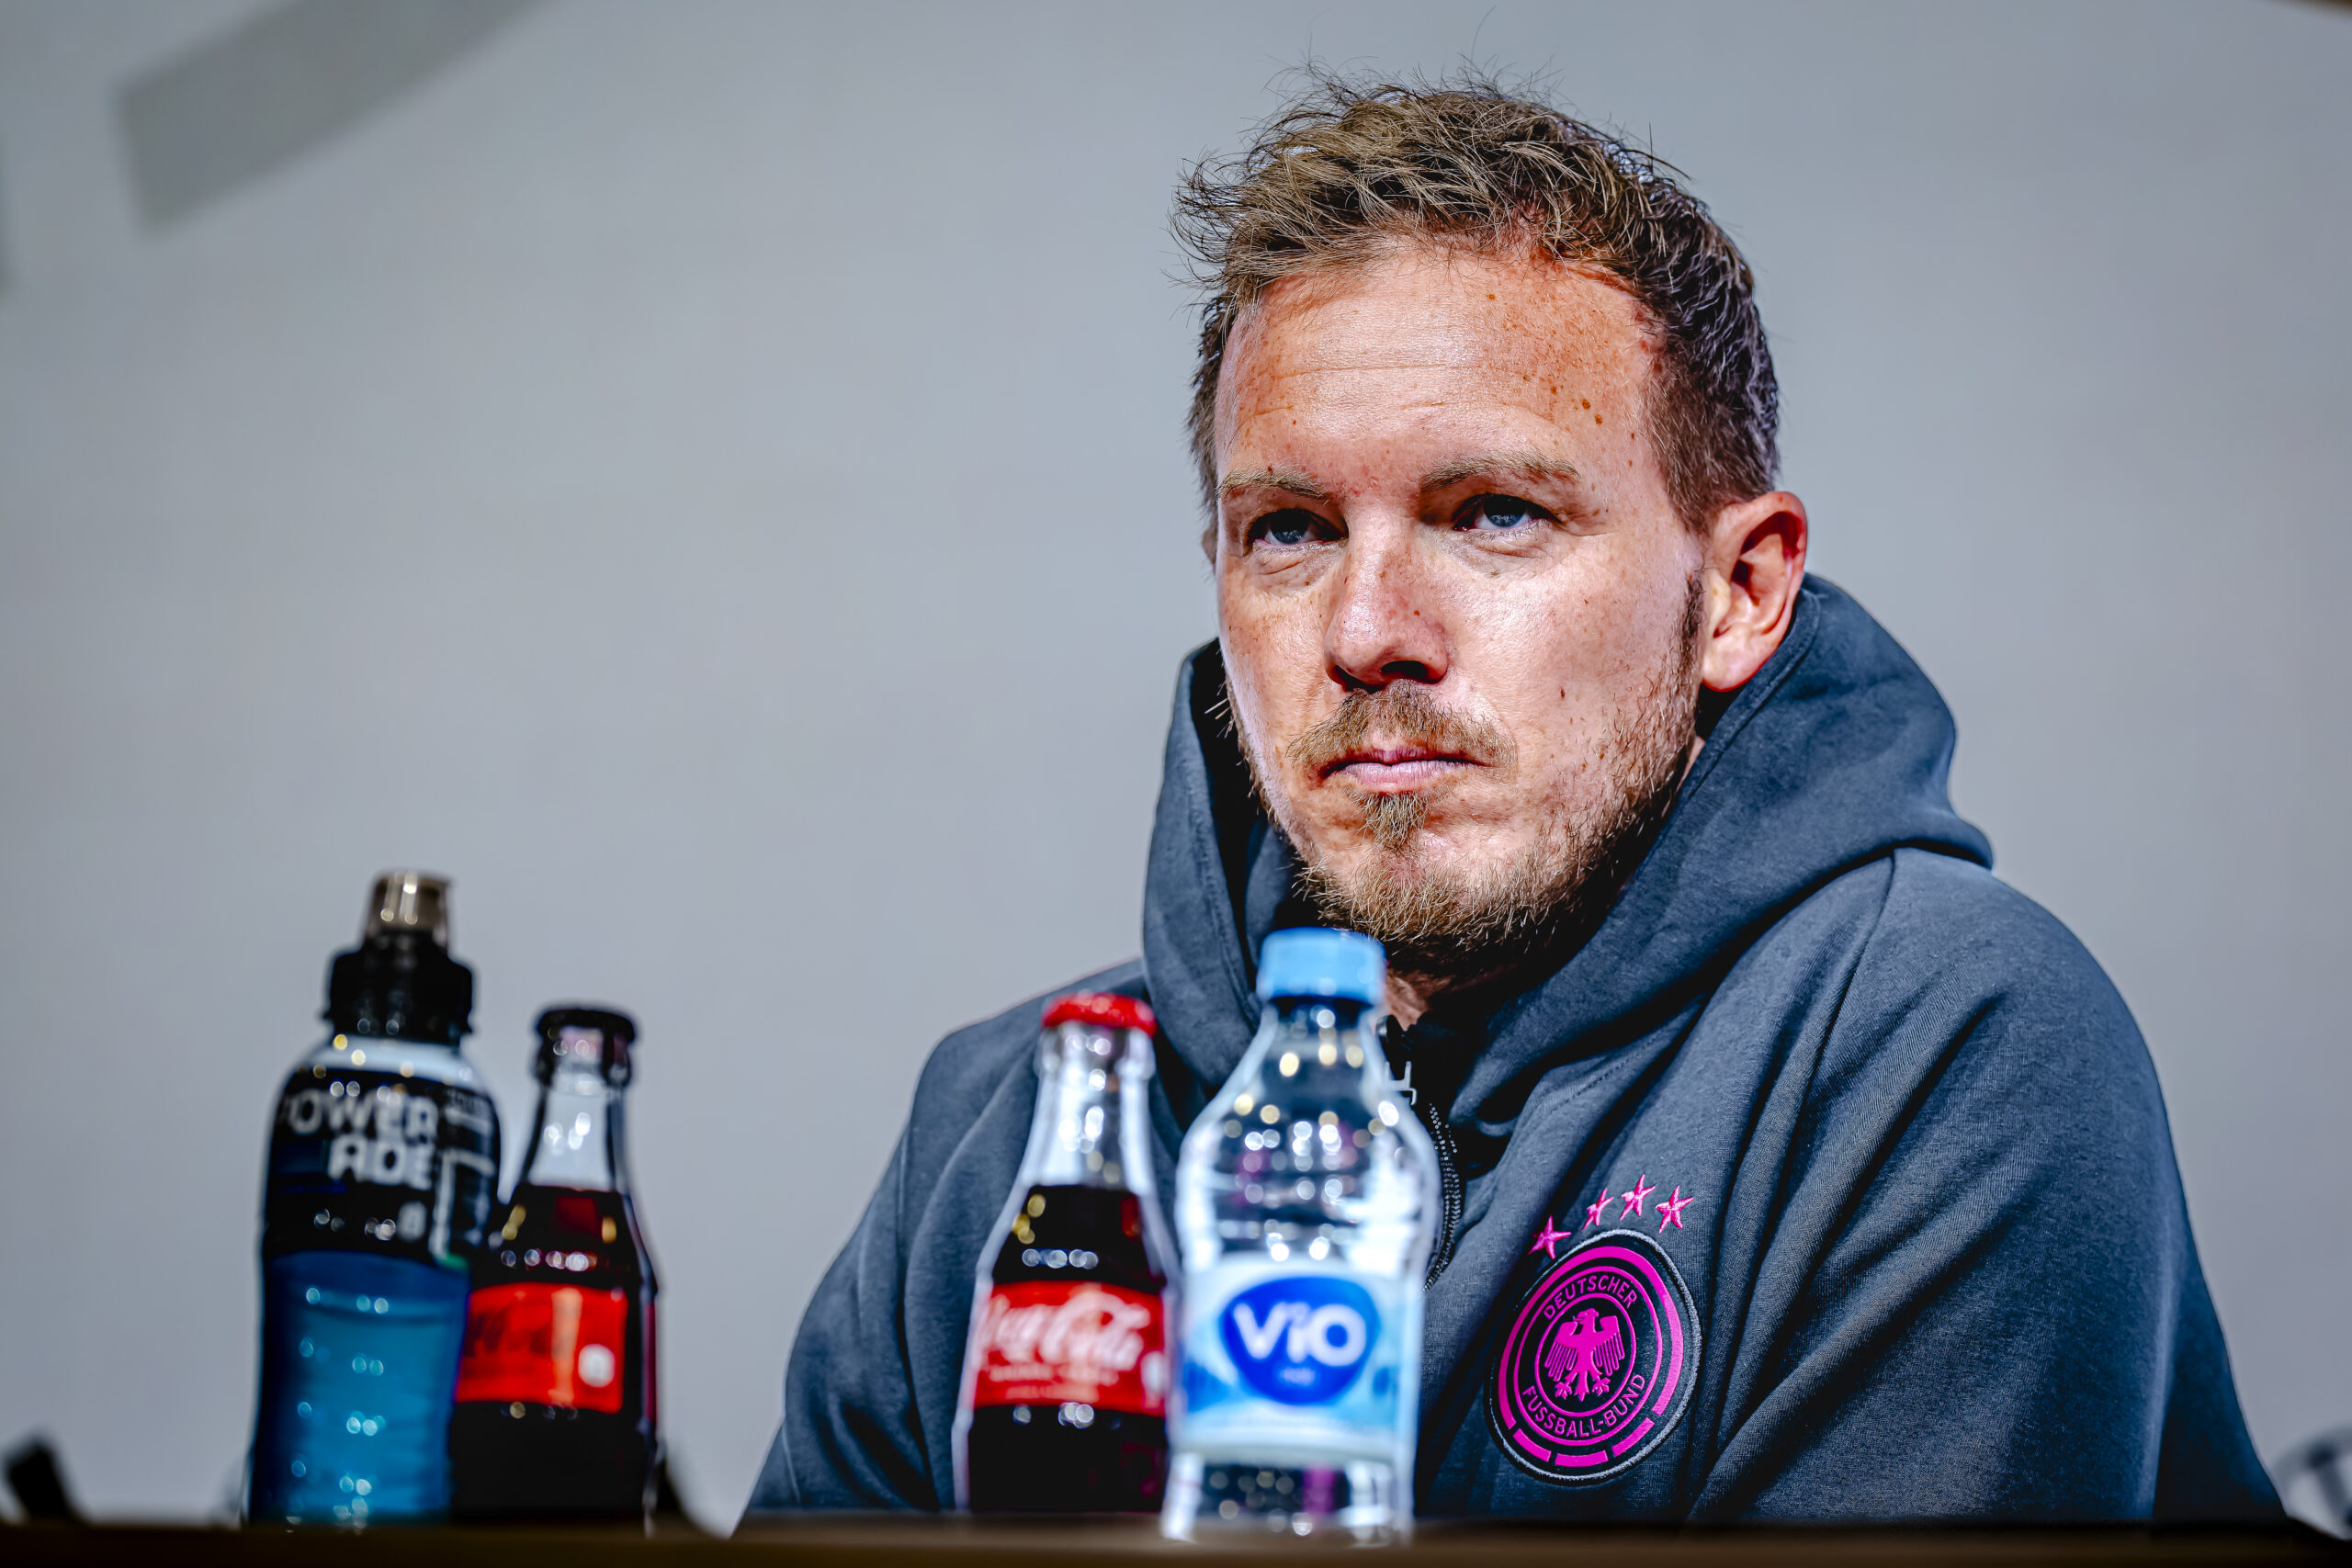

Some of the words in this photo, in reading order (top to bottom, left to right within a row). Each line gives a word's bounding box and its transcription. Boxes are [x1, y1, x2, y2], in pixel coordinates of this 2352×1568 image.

[328, 1133, 434, 1190] ADE
[1543, 1274, 1637, 1320] DEUTSCHER
[1521, 1374, 1645, 1438] FUSSBALL-BUND
